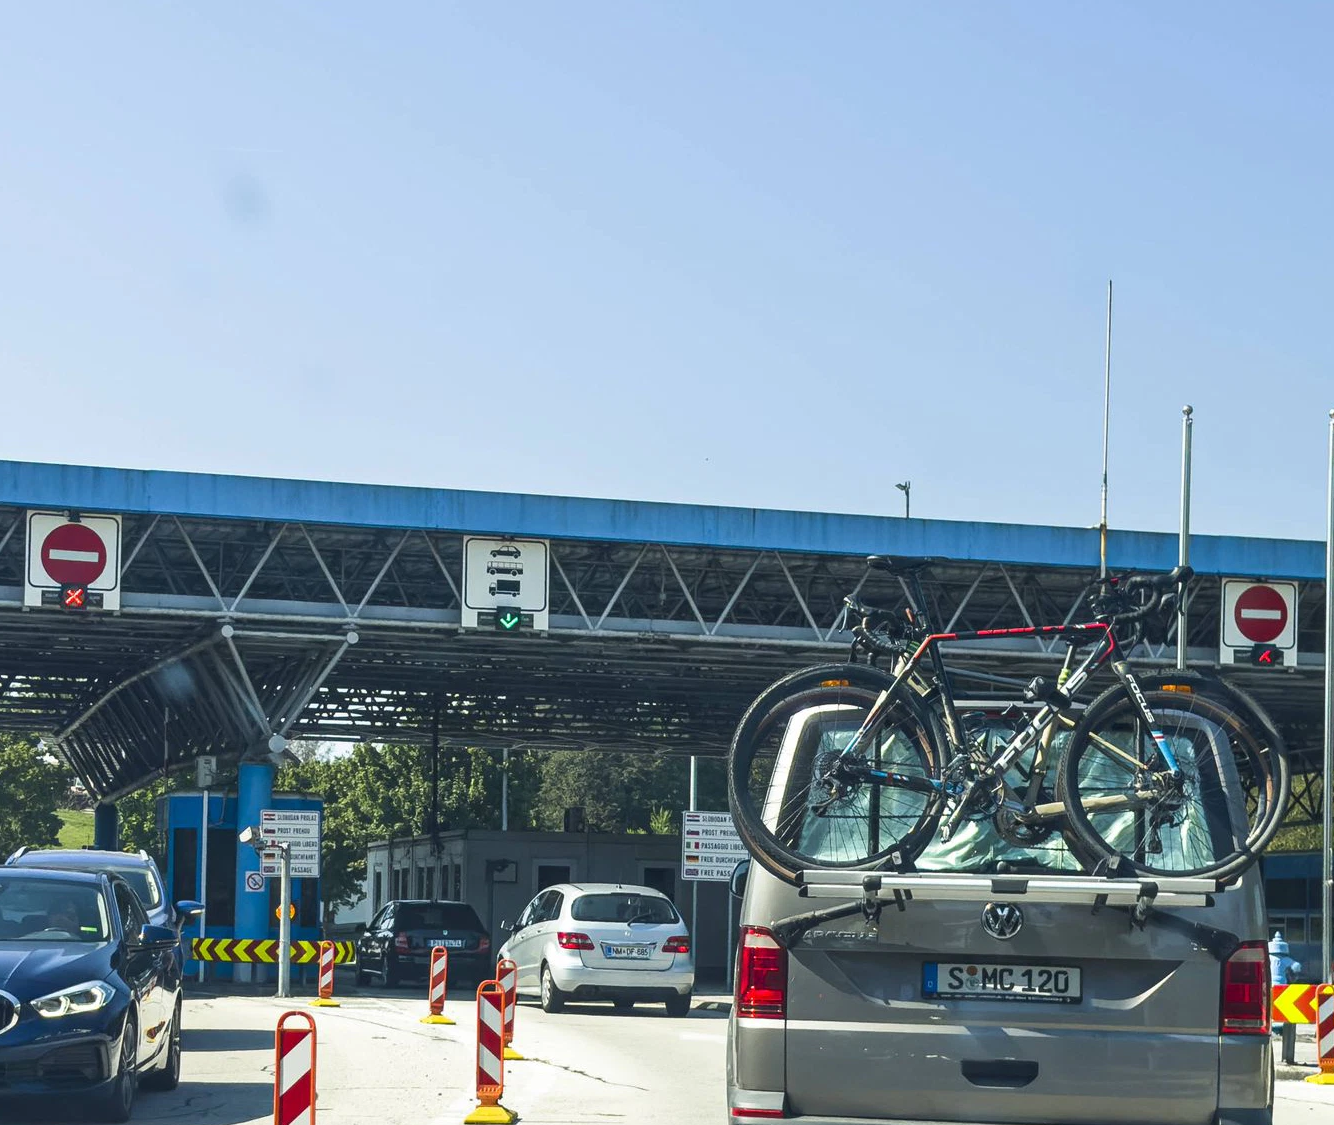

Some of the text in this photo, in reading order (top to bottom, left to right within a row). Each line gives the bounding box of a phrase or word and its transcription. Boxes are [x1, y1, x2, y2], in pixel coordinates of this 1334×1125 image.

[1125, 673, 1155, 723] FOCUS
[701, 842, 747, 851] PASSAGGIO LIBER
[947, 966, 964, 990] S
[981, 967, 1015, 991] MC
[1021, 968, 1069, 993] 120
